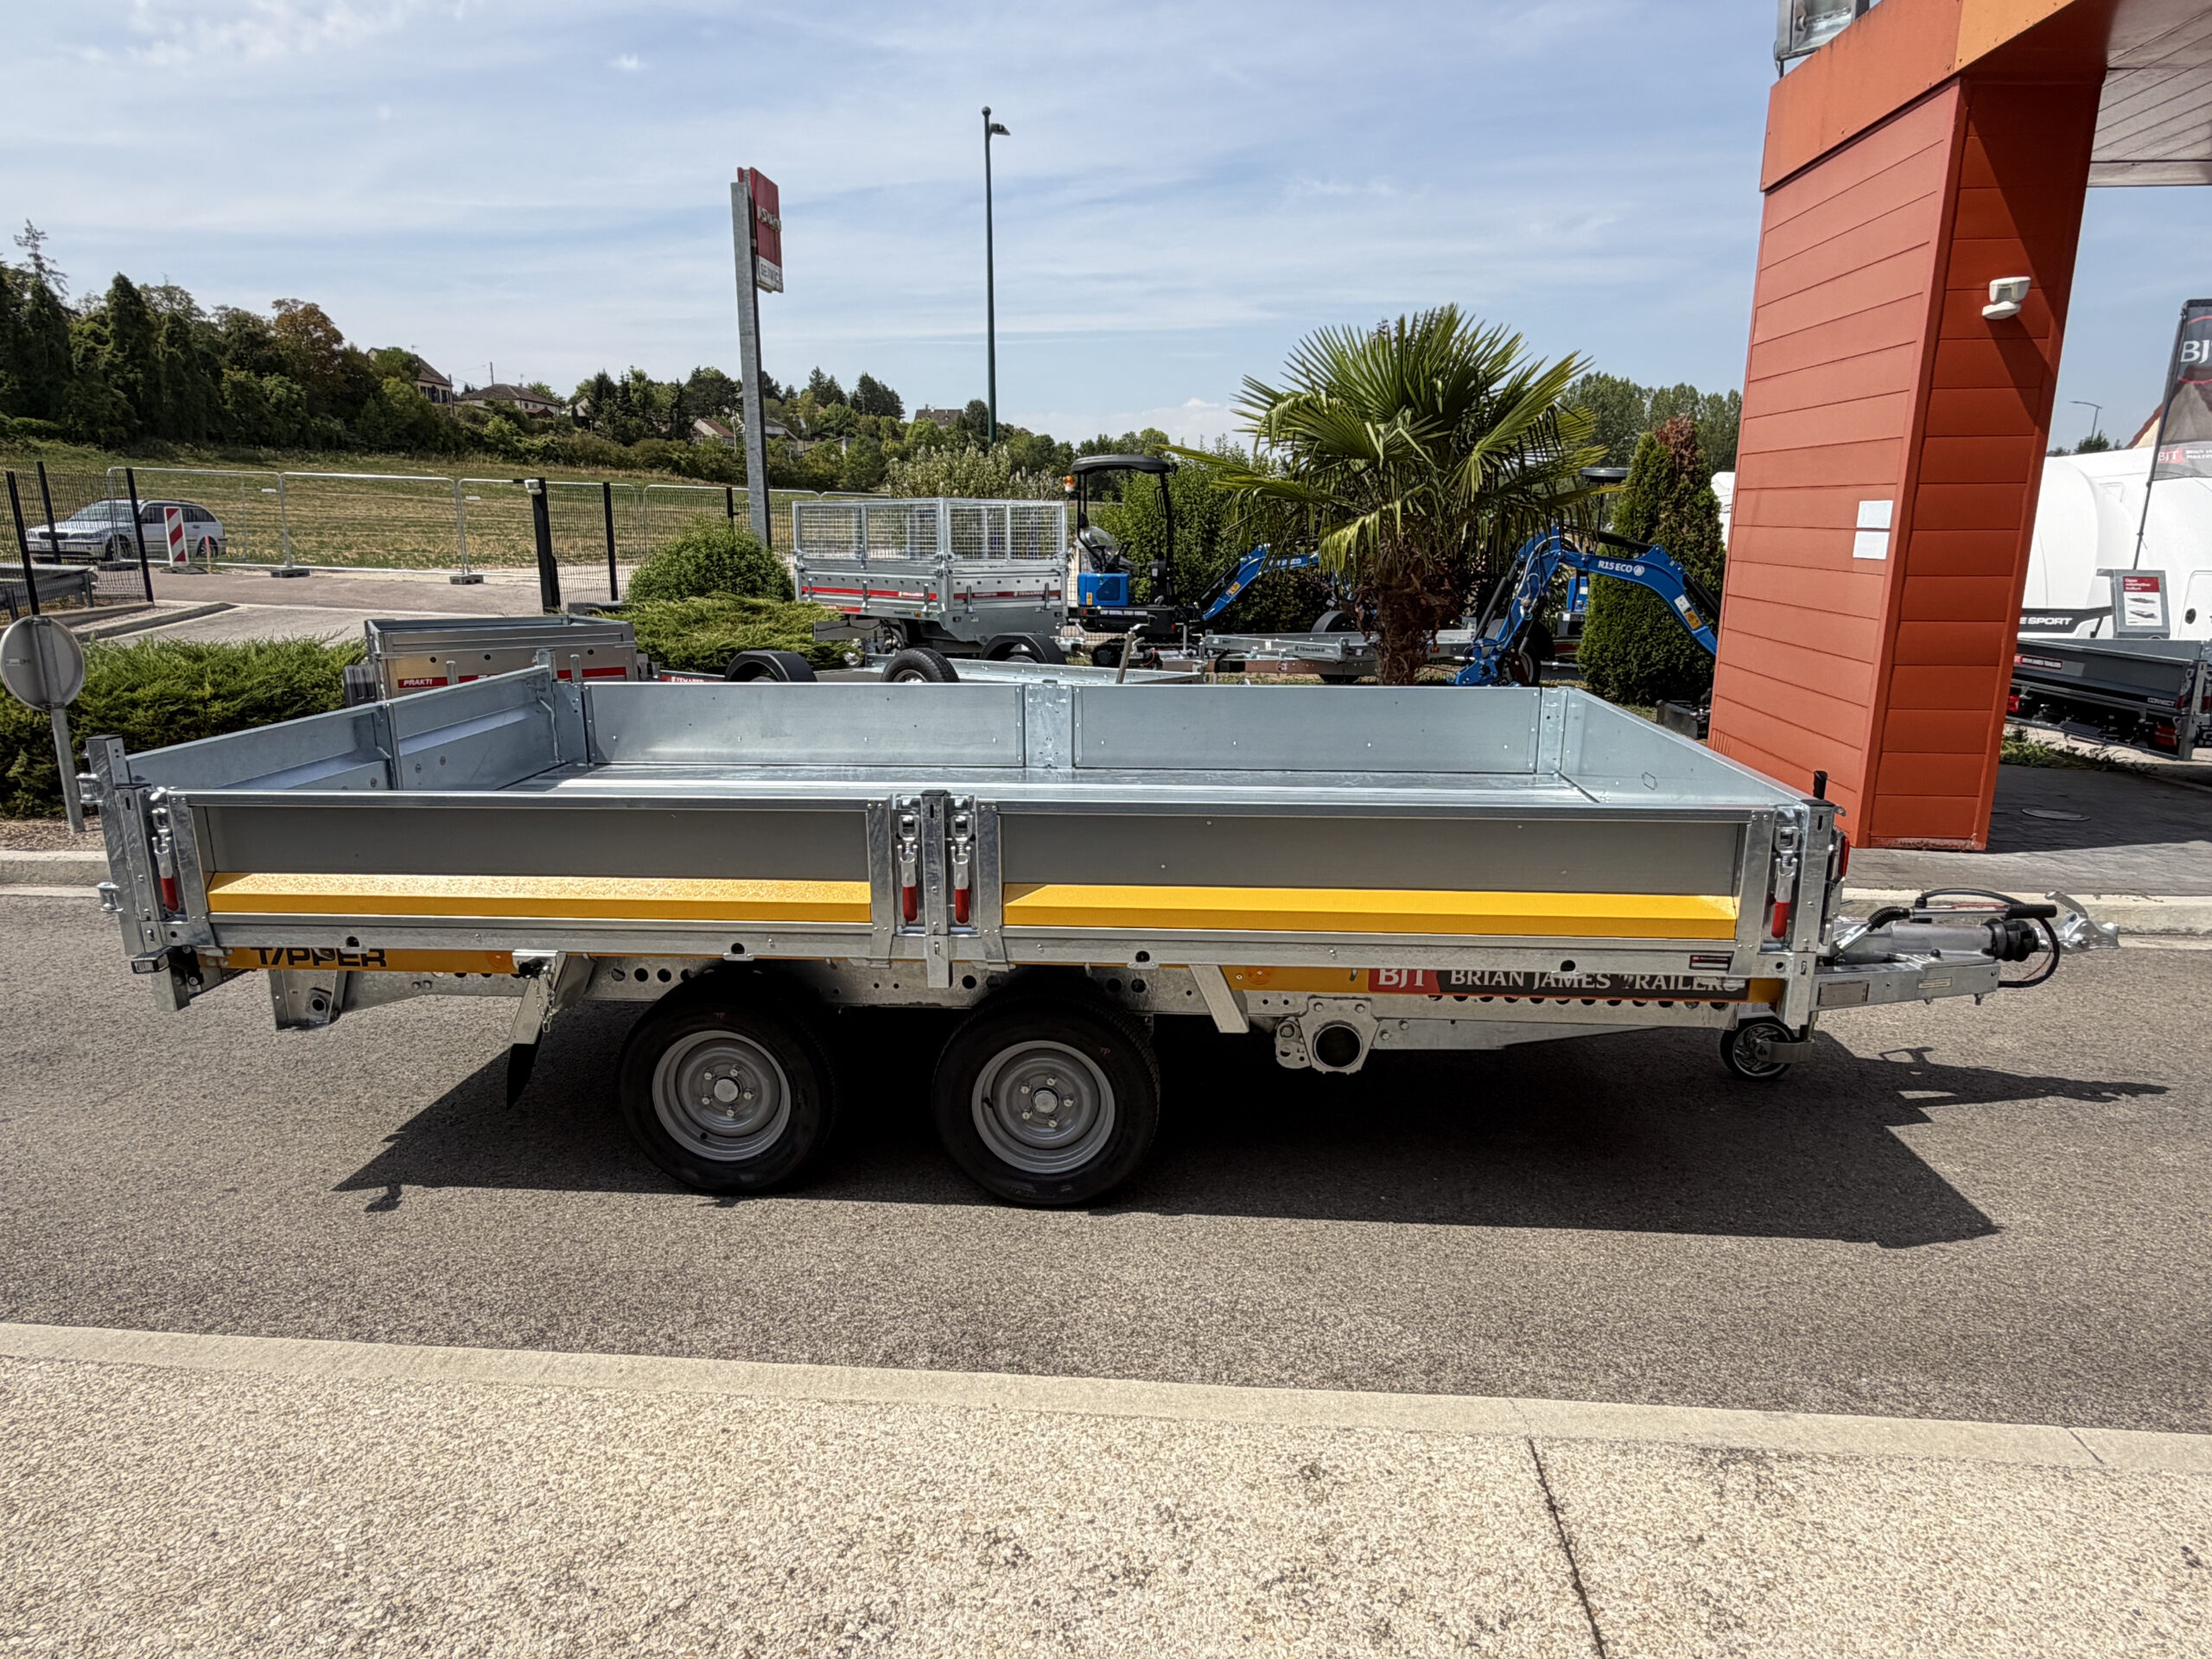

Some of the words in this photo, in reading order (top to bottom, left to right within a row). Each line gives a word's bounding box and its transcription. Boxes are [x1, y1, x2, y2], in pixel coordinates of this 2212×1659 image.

[2180, 340, 2212, 364] BJ
[2027, 617, 2073, 626] SPORT
[1377, 968, 1425, 989] BJT
[1450, 969, 1524, 988] BRIAN
[1532, 971, 1611, 990] JAMES
